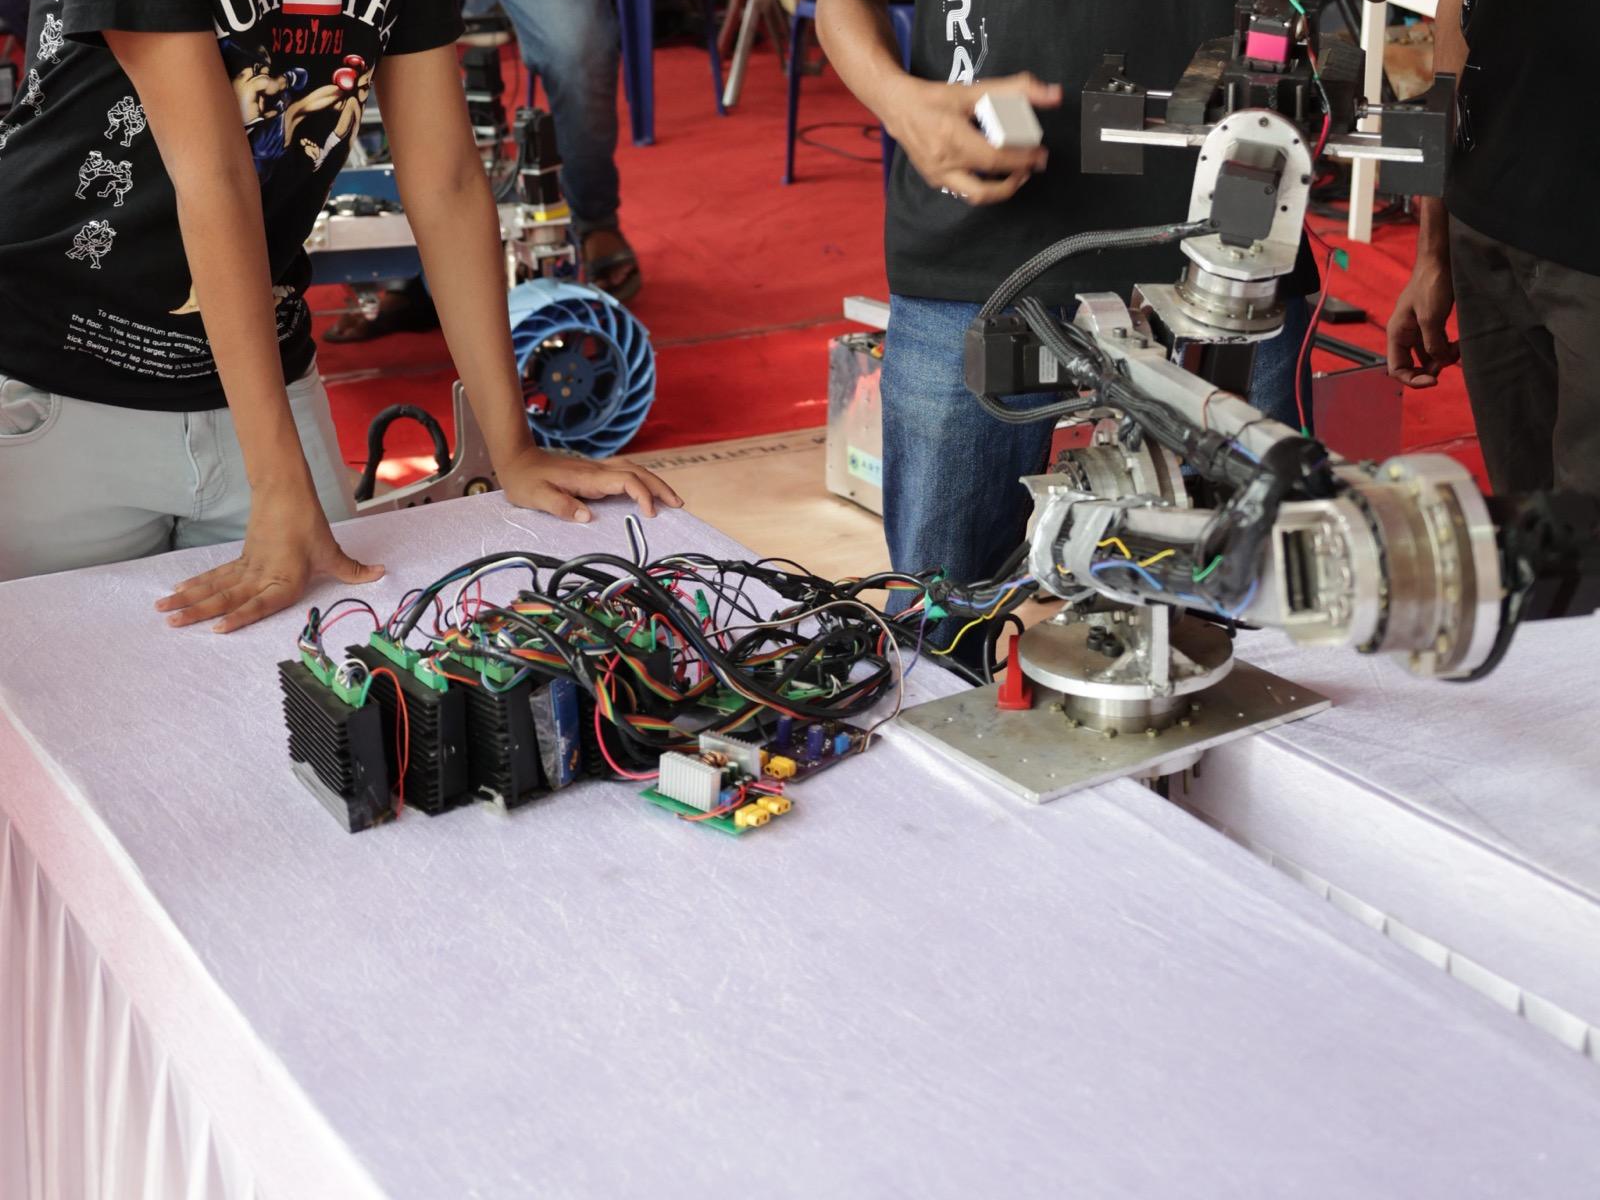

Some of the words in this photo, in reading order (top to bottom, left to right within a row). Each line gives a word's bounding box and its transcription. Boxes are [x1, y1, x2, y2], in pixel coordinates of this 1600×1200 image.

[71, 314, 84, 324] the
[86, 319, 103, 330] floor.
[109, 325, 124, 337] This
[126, 332, 141, 342] kick
[174, 342, 201, 354] straight
[97, 308, 107, 318] To
[107, 314, 130, 326] attain
[131, 322, 166, 336] maximum
[66, 334, 83, 345] kick.
[86, 340, 109, 354] Swing
[110, 349, 127, 358] your
[129, 353, 141, 363] leg
[143, 345, 167, 358] target,
